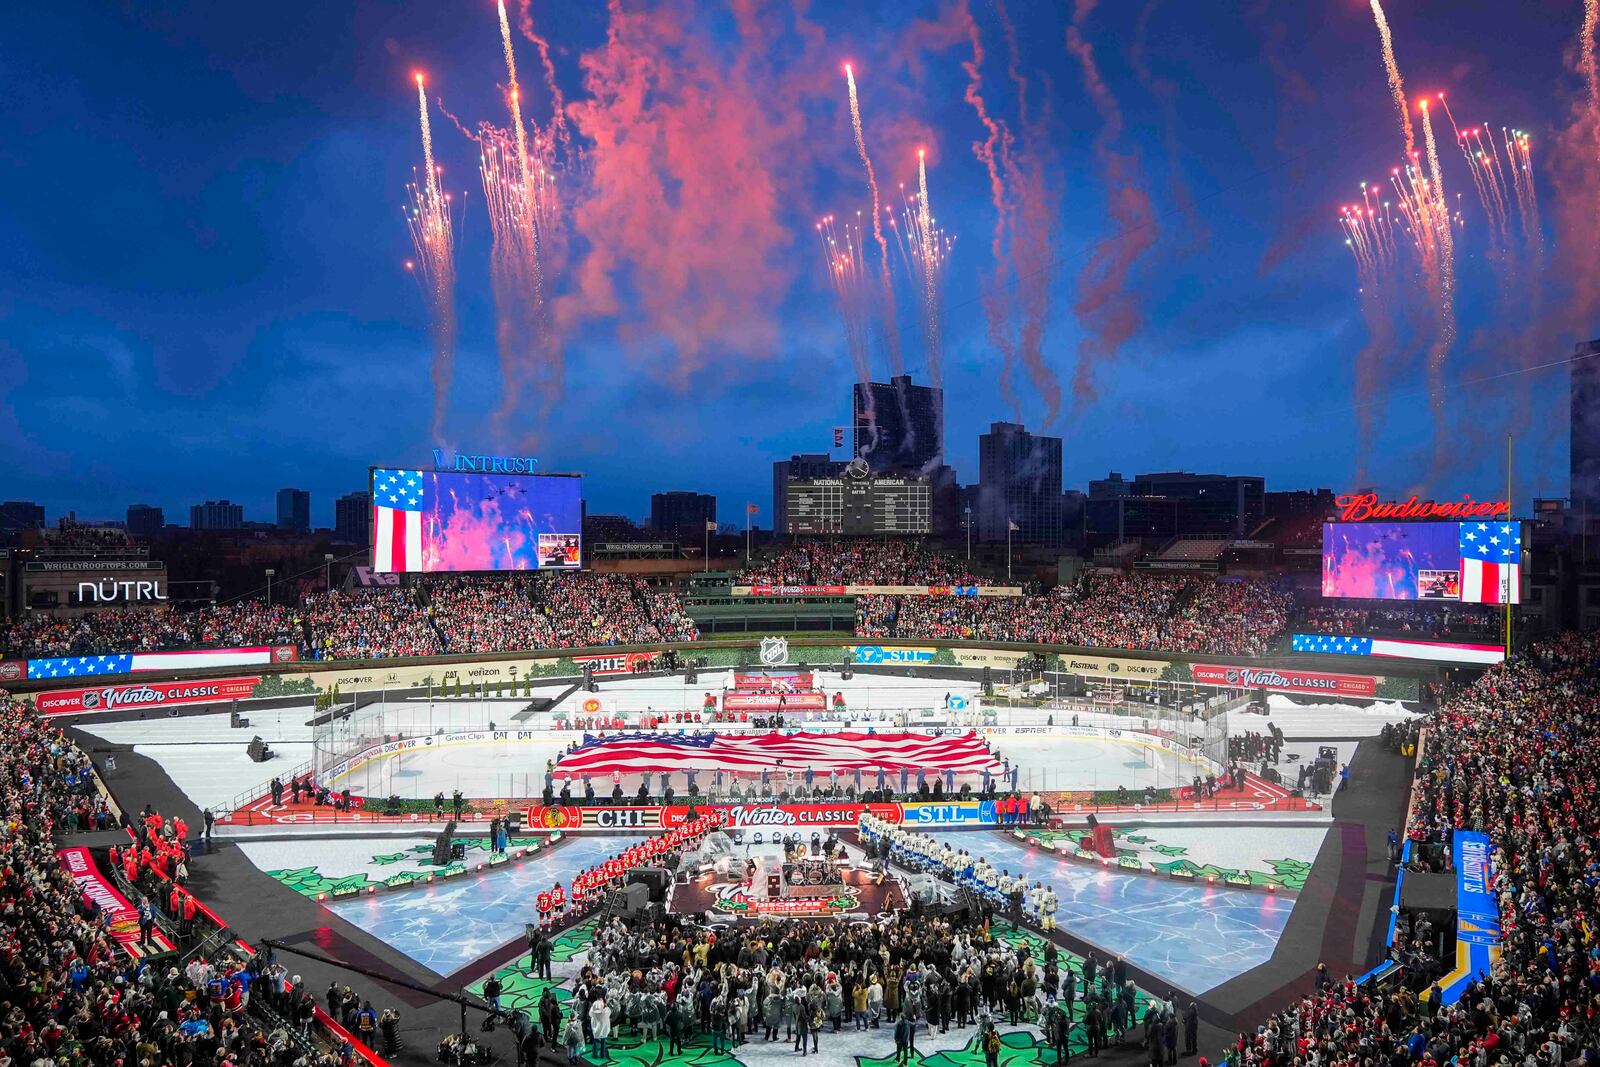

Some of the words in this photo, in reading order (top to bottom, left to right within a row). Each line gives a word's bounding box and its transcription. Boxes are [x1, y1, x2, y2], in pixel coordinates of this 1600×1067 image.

[1334, 493, 1512, 522] Budweiser
[890, 649, 923, 662] STL
[1070, 660, 1099, 670] FASTENAL
[1127, 665, 1157, 674] DISCOVER
[445, 670, 459, 679] CAT
[468, 668, 500, 677] verizon
[338, 676, 373, 685] DISCOVER
[1197, 671, 1225, 679] DISCOVER
[1240, 669, 1290, 687] Winter
[1292, 678, 1337, 689] CLASSIC
[42, 697, 80, 708] DISCOVER
[102, 686, 165, 709] Winter
[167, 686, 219, 698] CLASSIC
[445, 734, 466, 742] Great
[468, 732, 485, 740] Clips
[494, 731, 508, 740] CAT
[518, 731, 532, 740] CAT
[384, 740, 416, 753] DISCOVER
[597, 809, 645, 827] CHI
[730, 805, 796, 827] Winter
[799, 810, 854, 823] CLASSIC
[918, 805, 965, 823] STL
[1463, 862, 1483, 882] LOUIS
[1463, 882, 1484, 894] ST.
